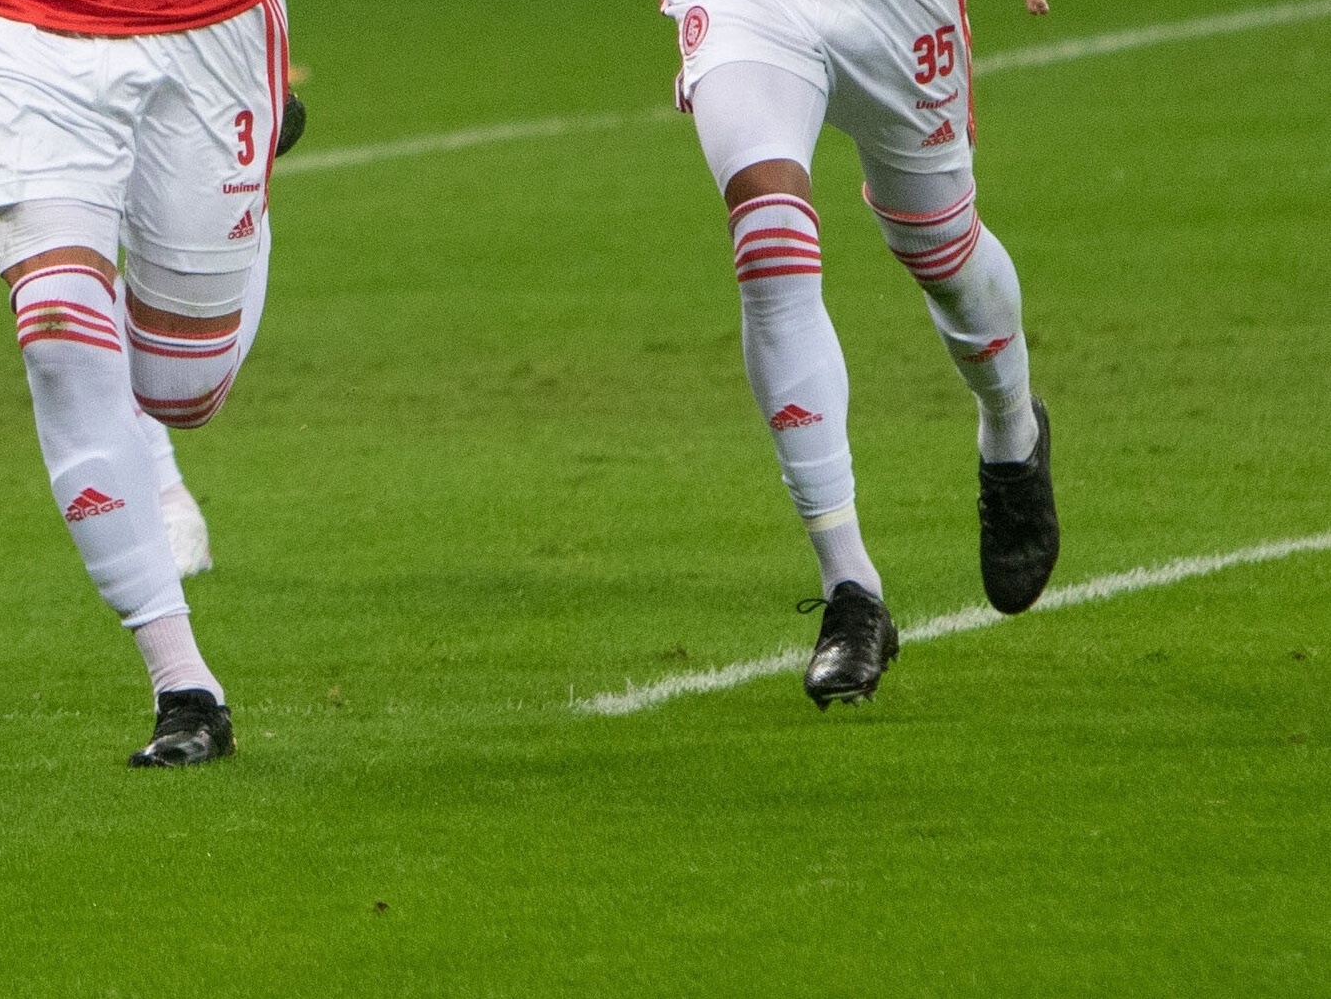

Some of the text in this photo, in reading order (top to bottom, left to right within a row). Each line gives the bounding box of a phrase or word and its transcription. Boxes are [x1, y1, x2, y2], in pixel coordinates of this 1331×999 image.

[912, 24, 956, 85] 35
[234, 109, 255, 166] 3
[64, 498, 126, 522] adidas
